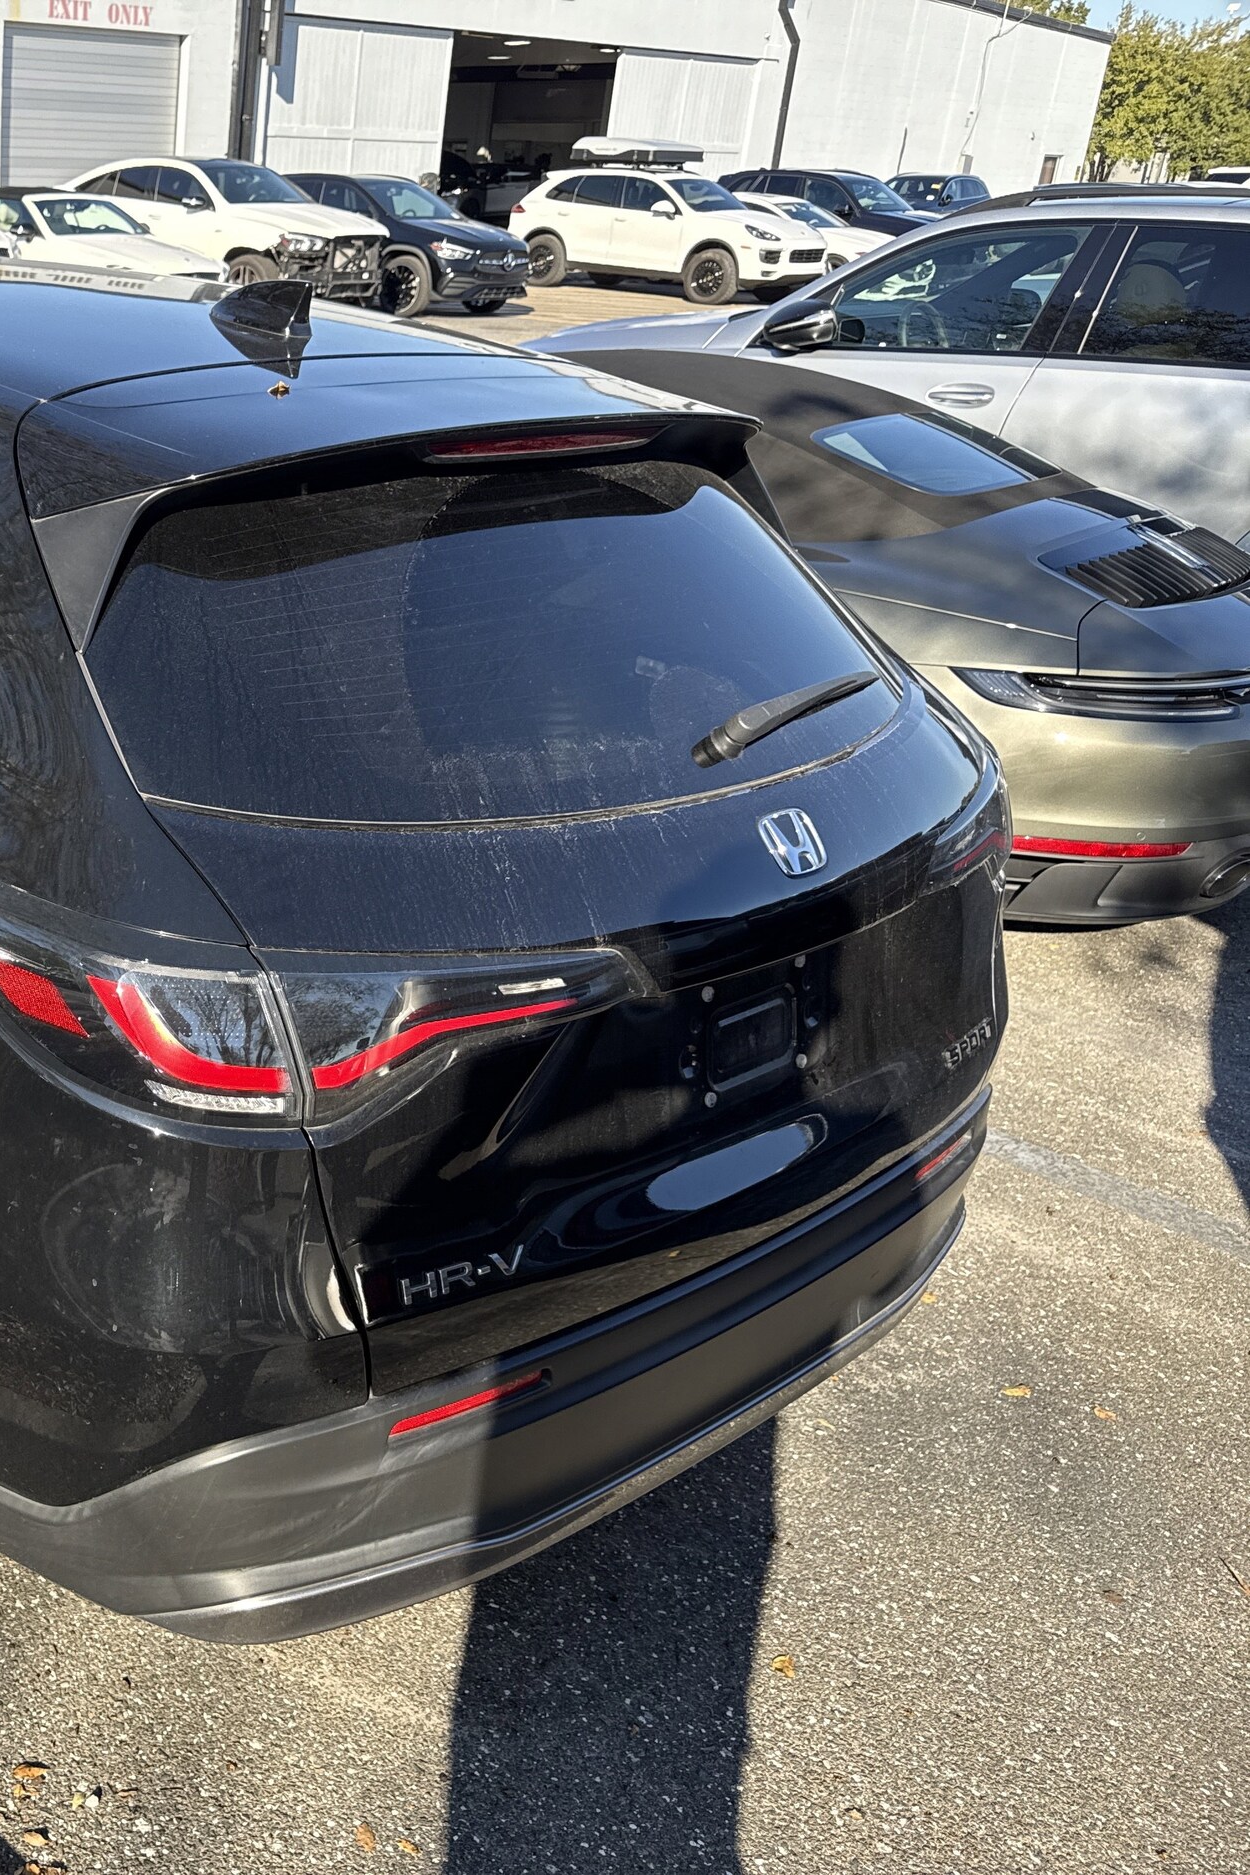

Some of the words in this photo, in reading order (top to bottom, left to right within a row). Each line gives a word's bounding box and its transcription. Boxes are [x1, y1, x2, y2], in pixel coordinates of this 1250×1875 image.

[48, 0, 92, 22] EXIT
[108, 3, 154, 27] ONLY
[941, 1016, 993, 1070] SPORT
[399, 1244, 525, 1306] HR-V
